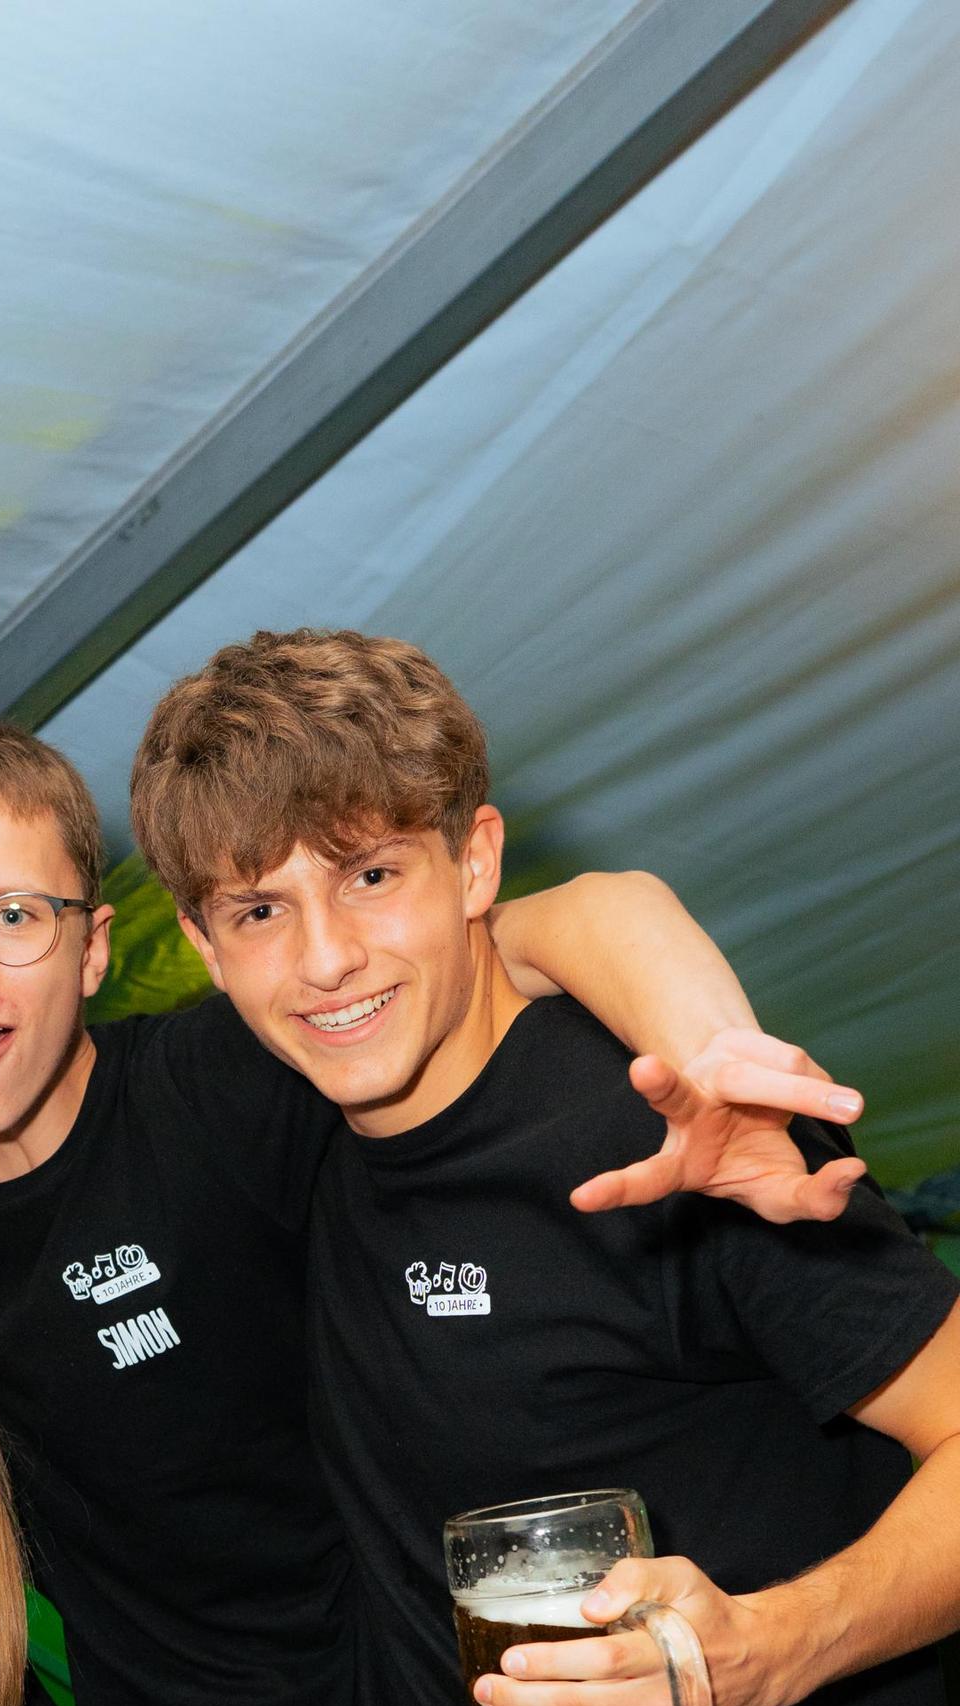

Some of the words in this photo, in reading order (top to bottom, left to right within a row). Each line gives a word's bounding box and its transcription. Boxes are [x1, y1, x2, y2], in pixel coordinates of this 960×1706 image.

[102, 1286, 115, 1297] 10
[115, 1271, 147, 1293] JAHRE
[434, 1301, 446, 1311] 10
[447, 1299, 477, 1312] JAHRE
[97, 1307, 181, 1370] SIMON
